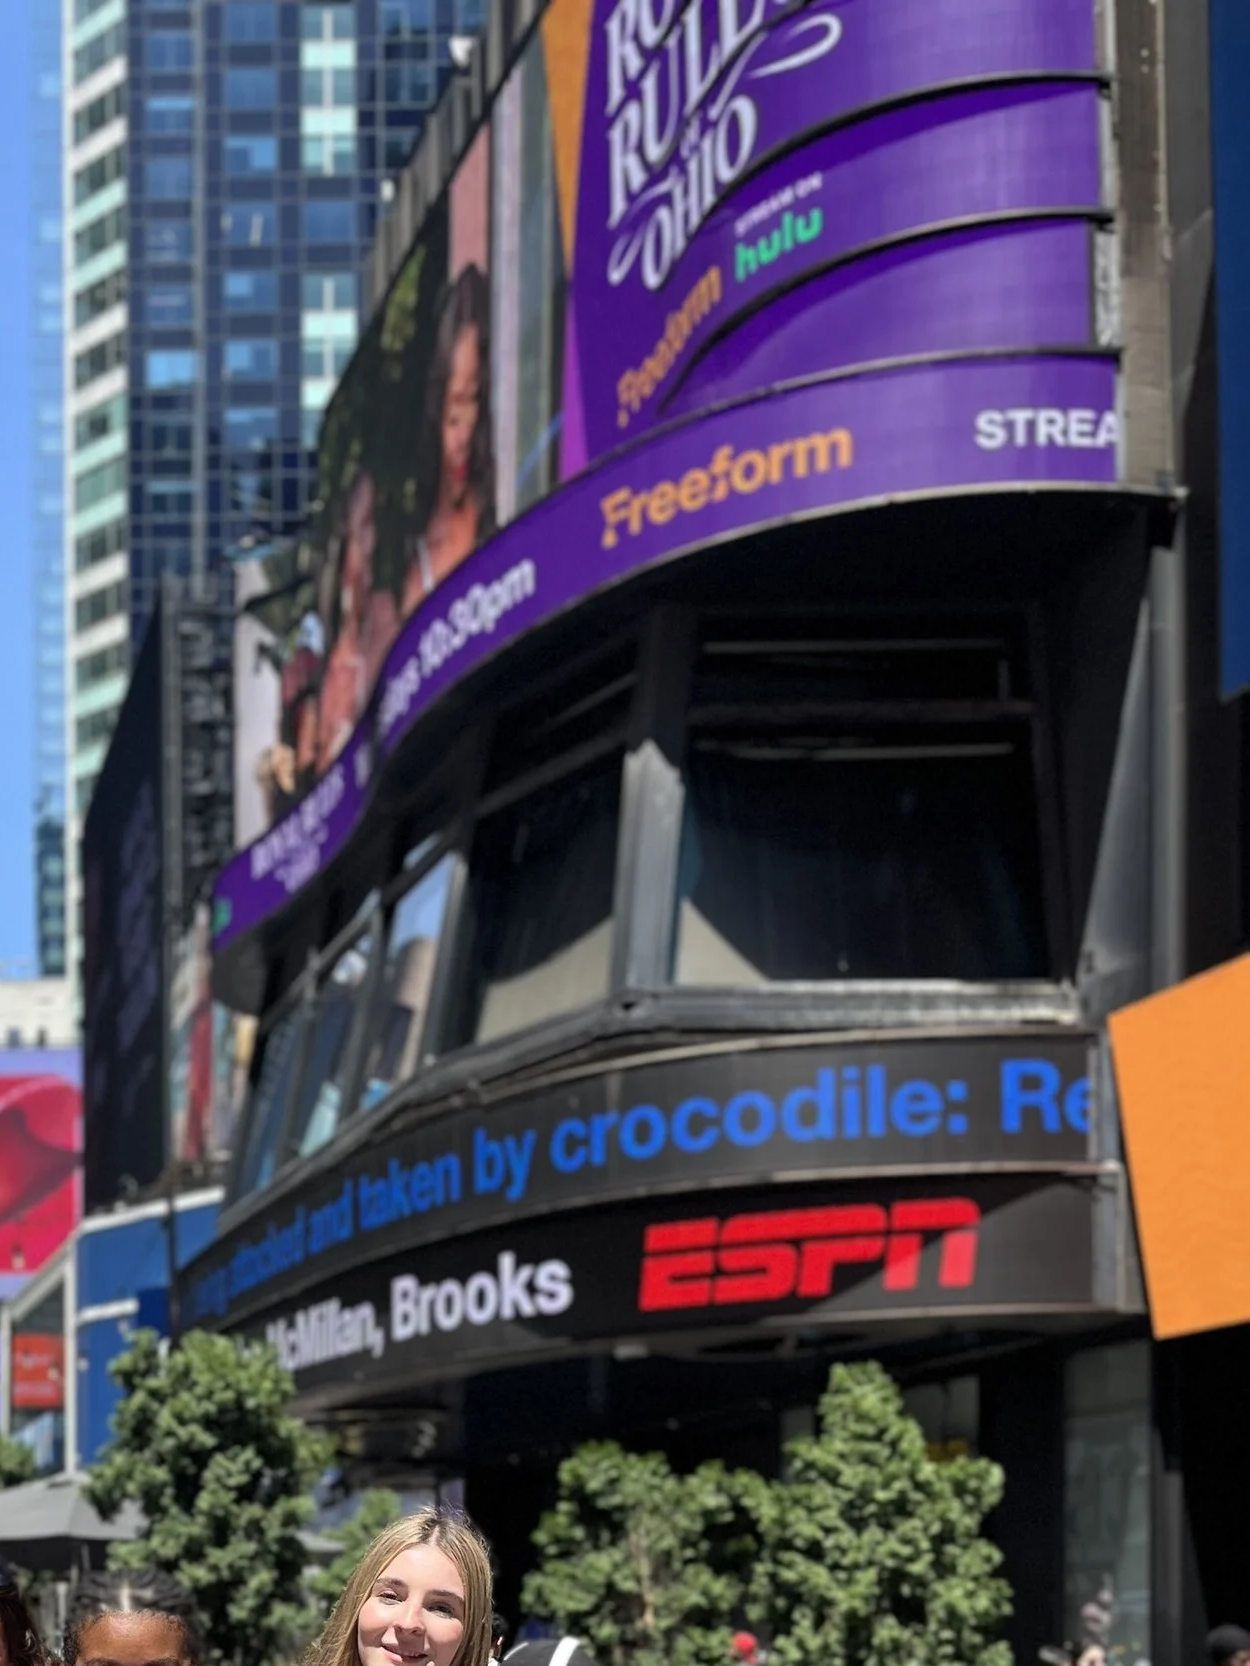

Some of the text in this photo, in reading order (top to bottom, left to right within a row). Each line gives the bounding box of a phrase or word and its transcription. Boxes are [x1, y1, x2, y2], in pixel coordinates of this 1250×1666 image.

[734, 206, 823, 283] hulu
[617, 264, 723, 430] Freeform
[601, 427, 854, 550] Freeform
[418, 557, 537, 679] 10:30pm
[358, 1152, 461, 1232] taken
[473, 1126, 537, 1201] by
[550, 1062, 969, 1174] crocodile:
[390, 1250, 573, 1341] Brooks
[638, 1196, 982, 1312] ESPN
